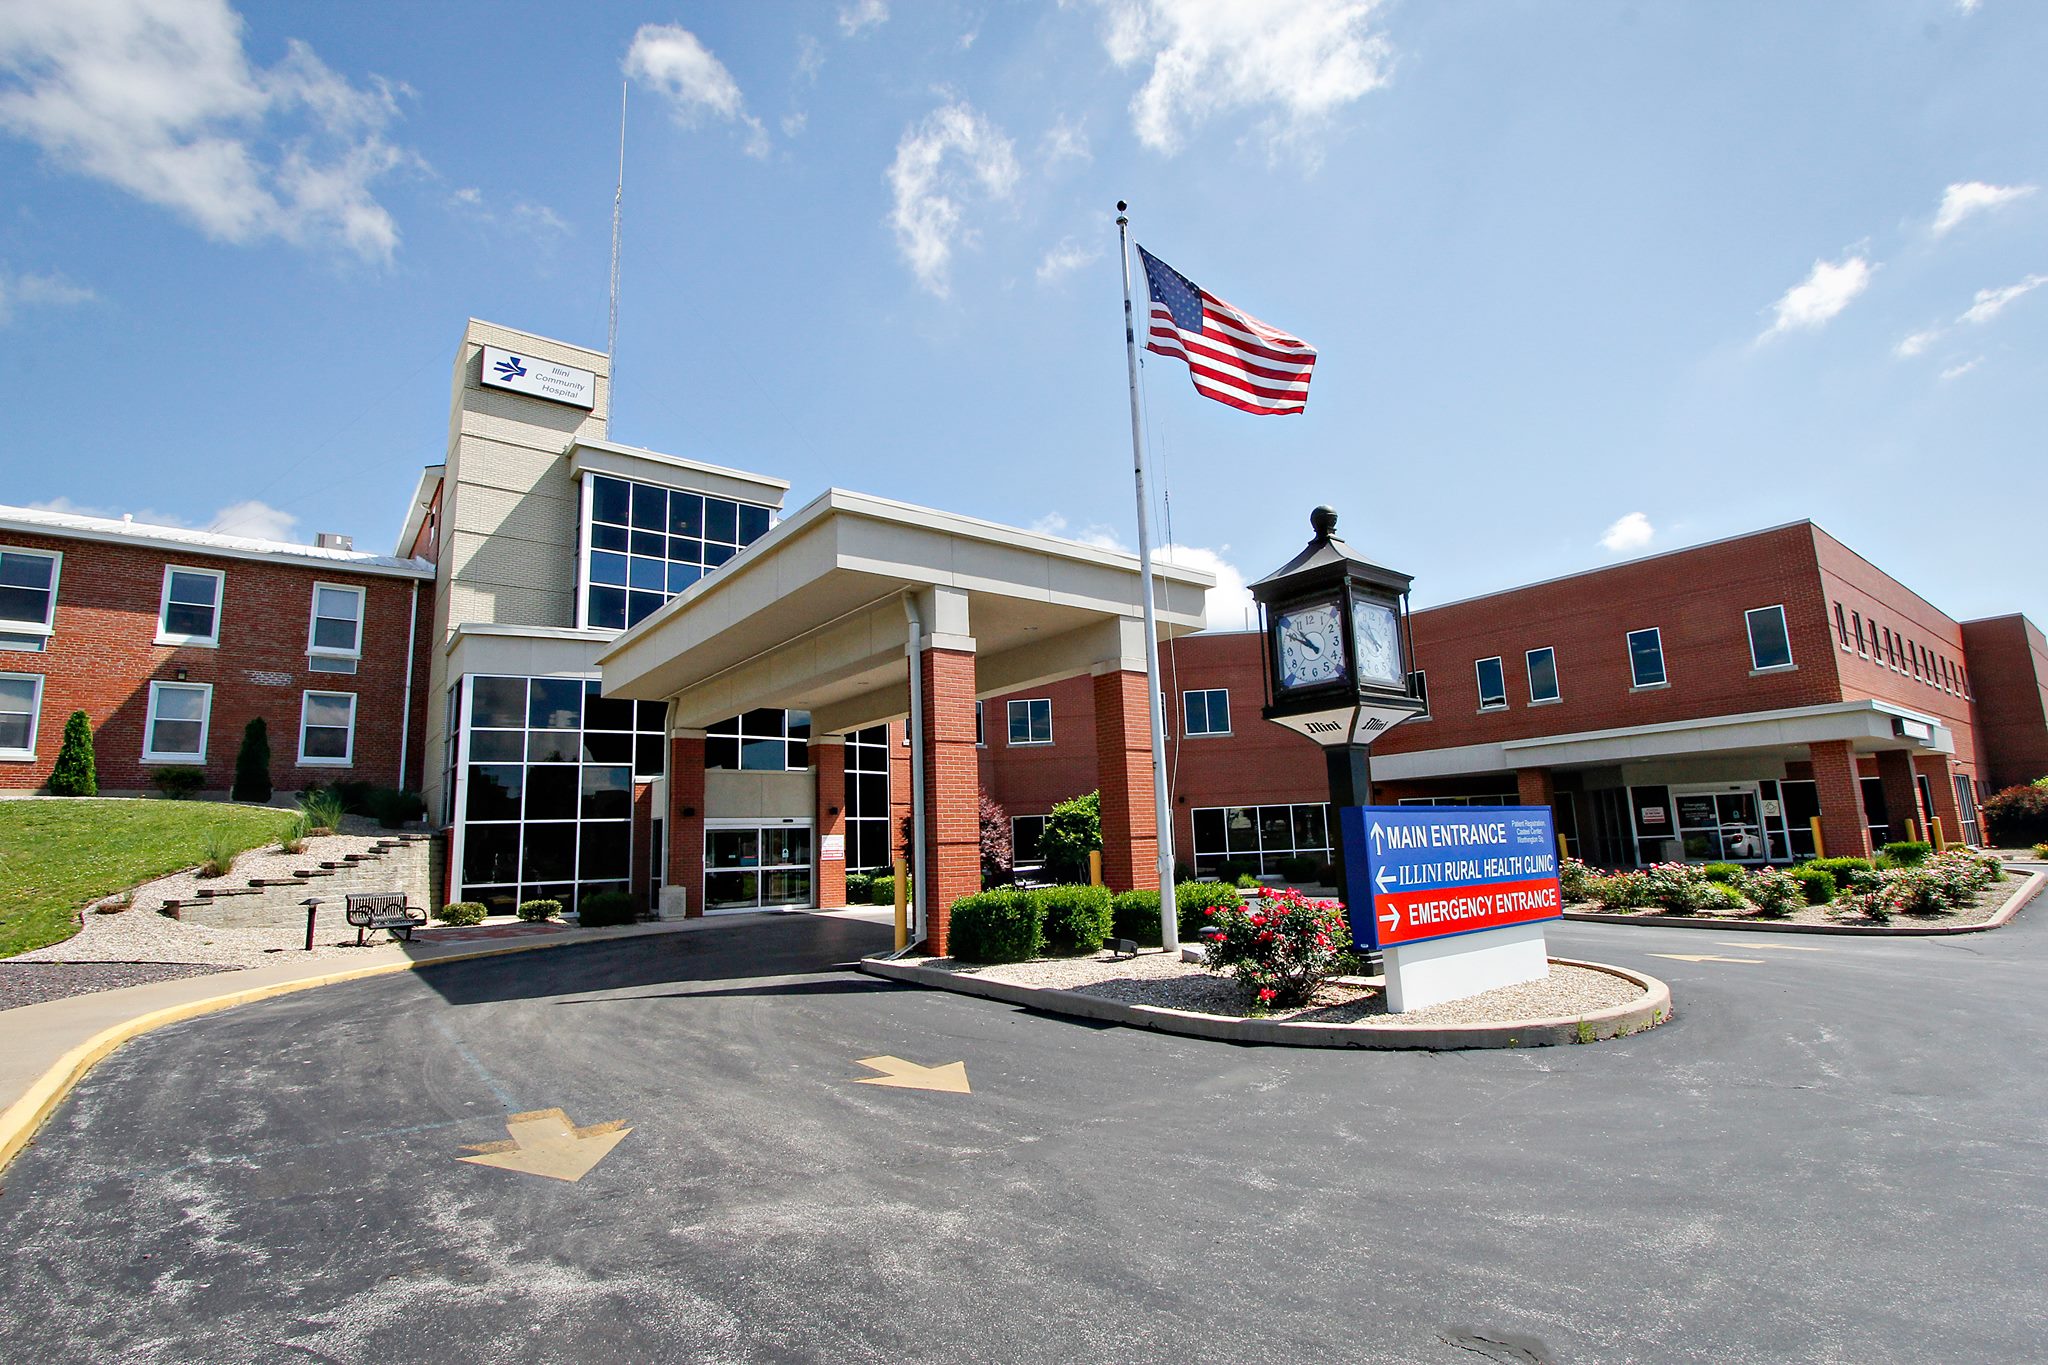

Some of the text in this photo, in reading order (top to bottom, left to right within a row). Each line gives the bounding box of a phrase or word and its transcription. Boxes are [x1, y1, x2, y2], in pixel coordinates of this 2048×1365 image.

[552, 367, 570, 378] Illini
[535, 373, 585, 391] Community
[542, 384, 579, 398] Hospital
[1304, 720, 1342, 733] Illini
[1361, 717, 1389, 731] Illini
[1386, 823, 1507, 849] MAIN ENTRANCE
[1399, 854, 1554, 886] ILLINI RURAL HEALTH CLINIC
[1408, 888, 1557, 925] EMERGENCY ENTRANCE
